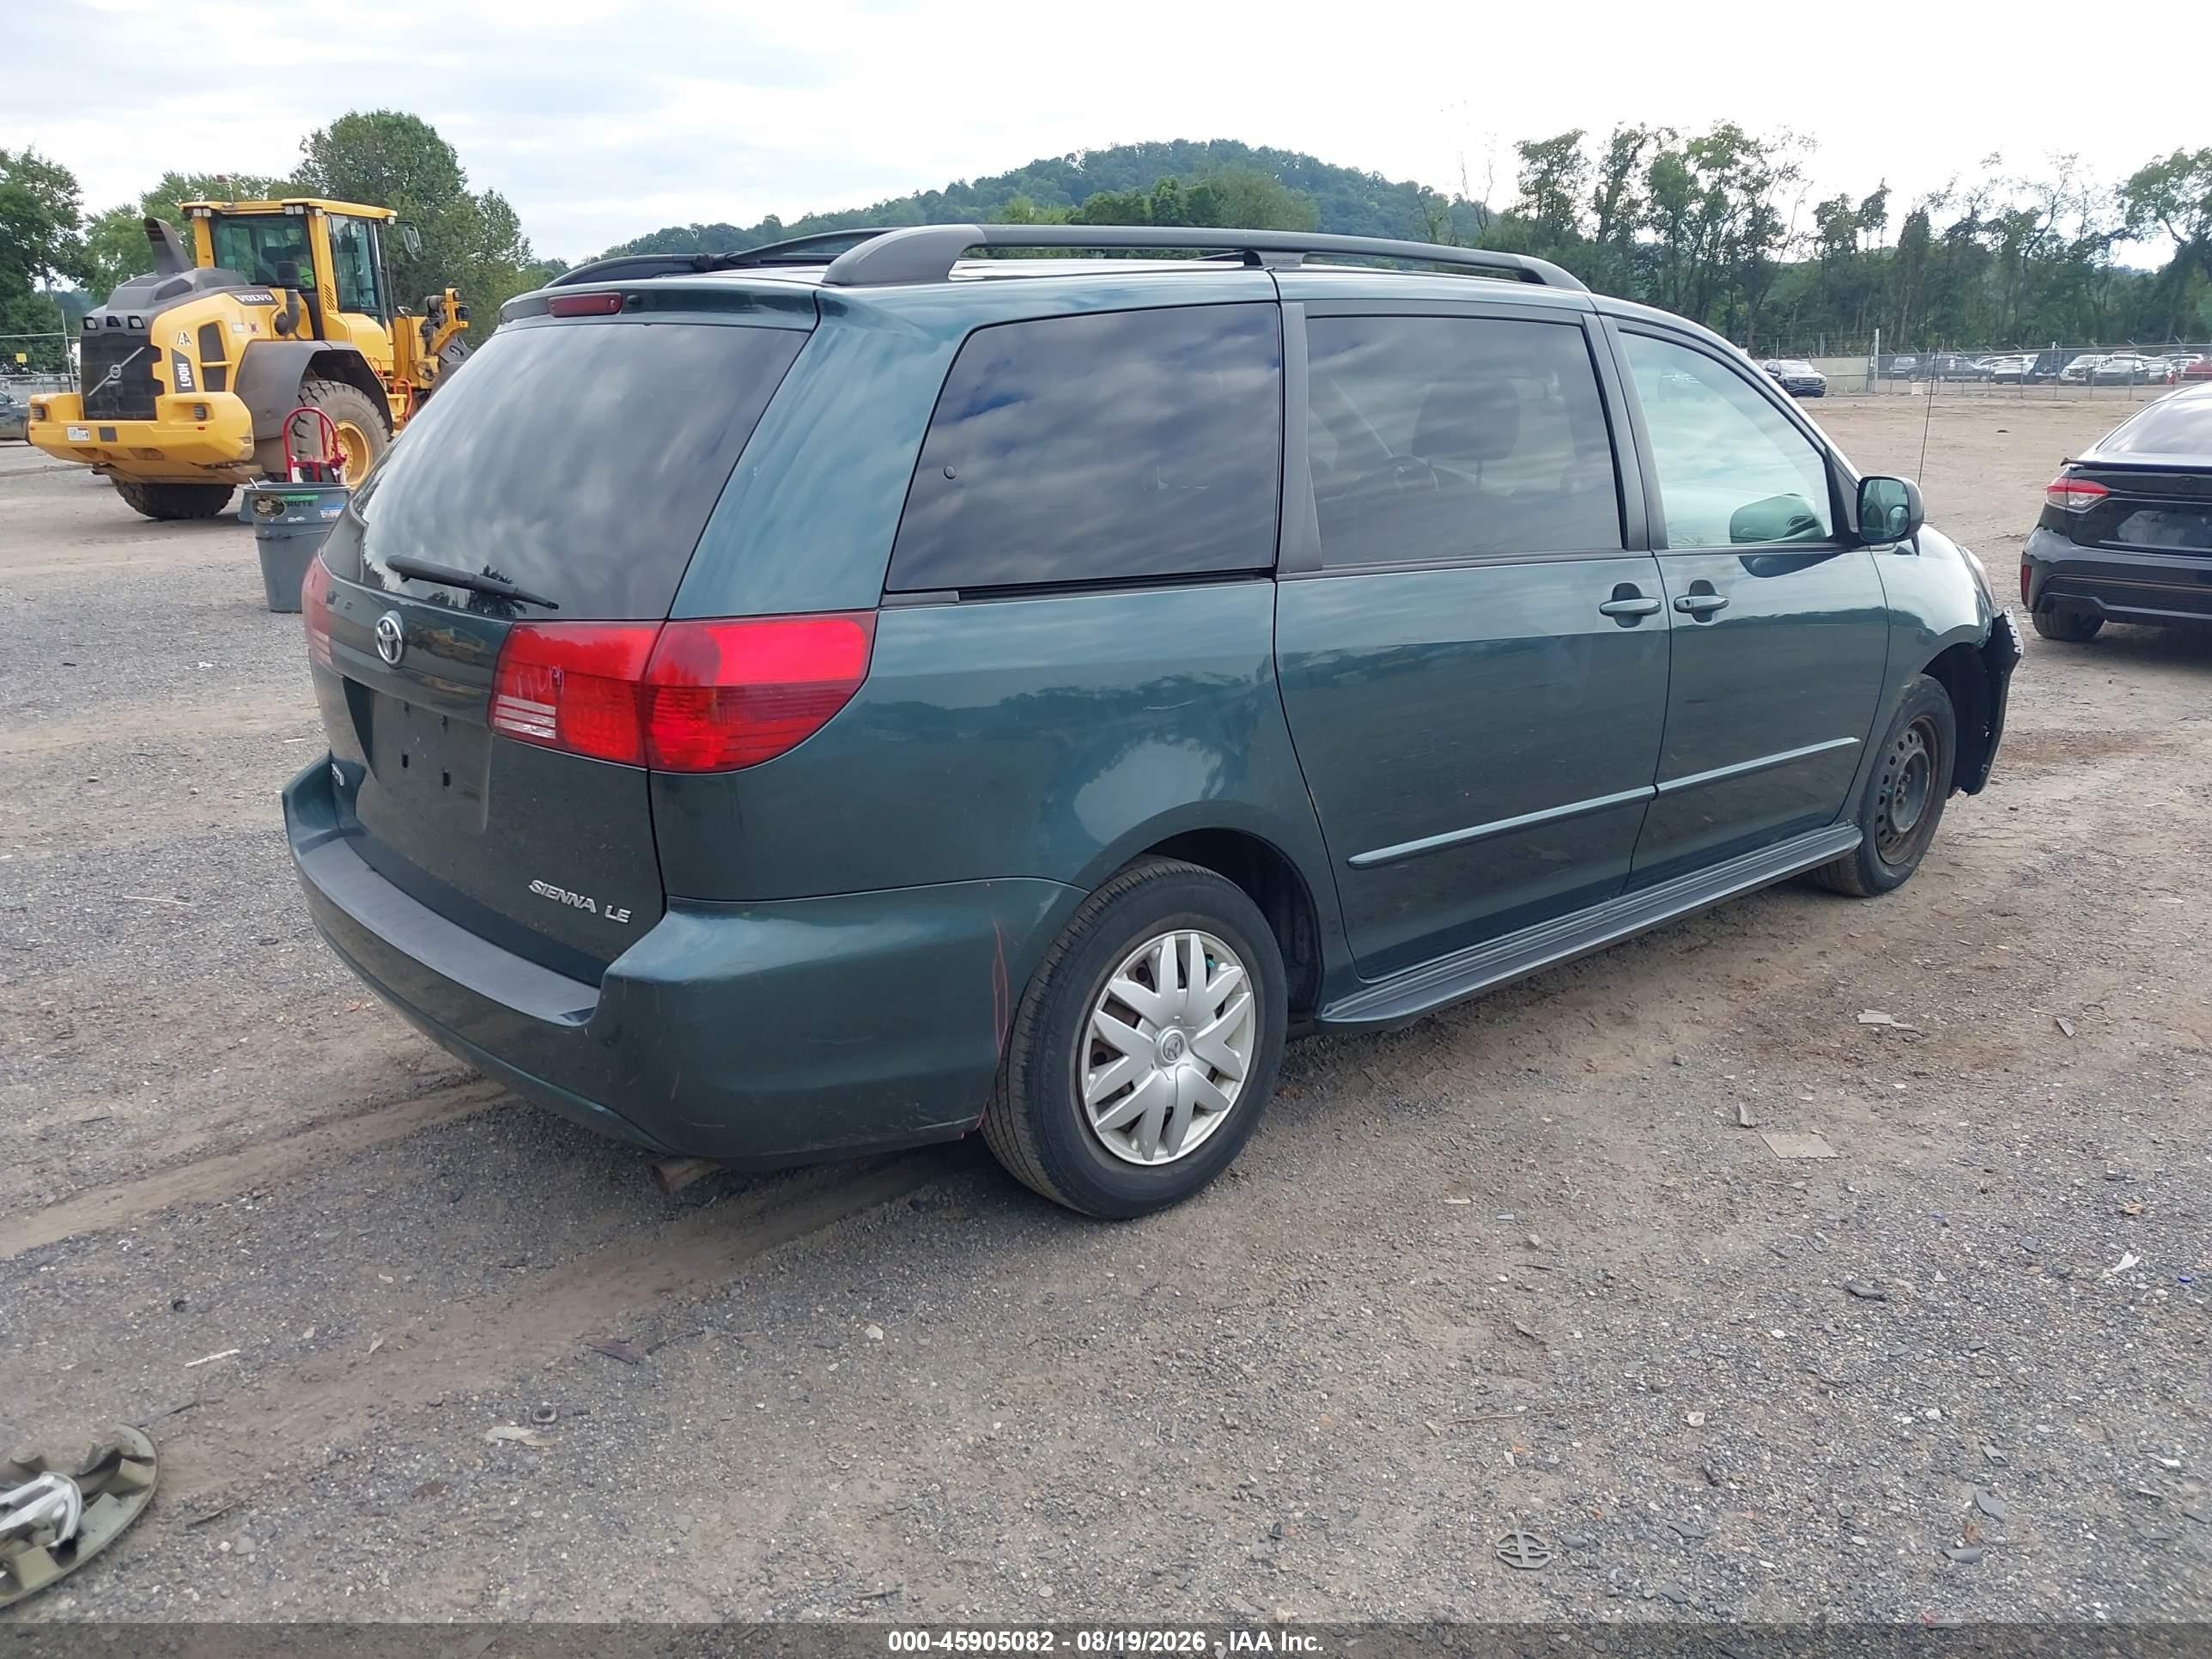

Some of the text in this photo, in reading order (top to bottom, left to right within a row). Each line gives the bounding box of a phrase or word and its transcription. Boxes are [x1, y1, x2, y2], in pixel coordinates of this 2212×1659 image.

[234, 294, 273, 302] VOLVO
[177, 362, 193, 387] L90H
[528, 879, 632, 923] SIENNA LE
